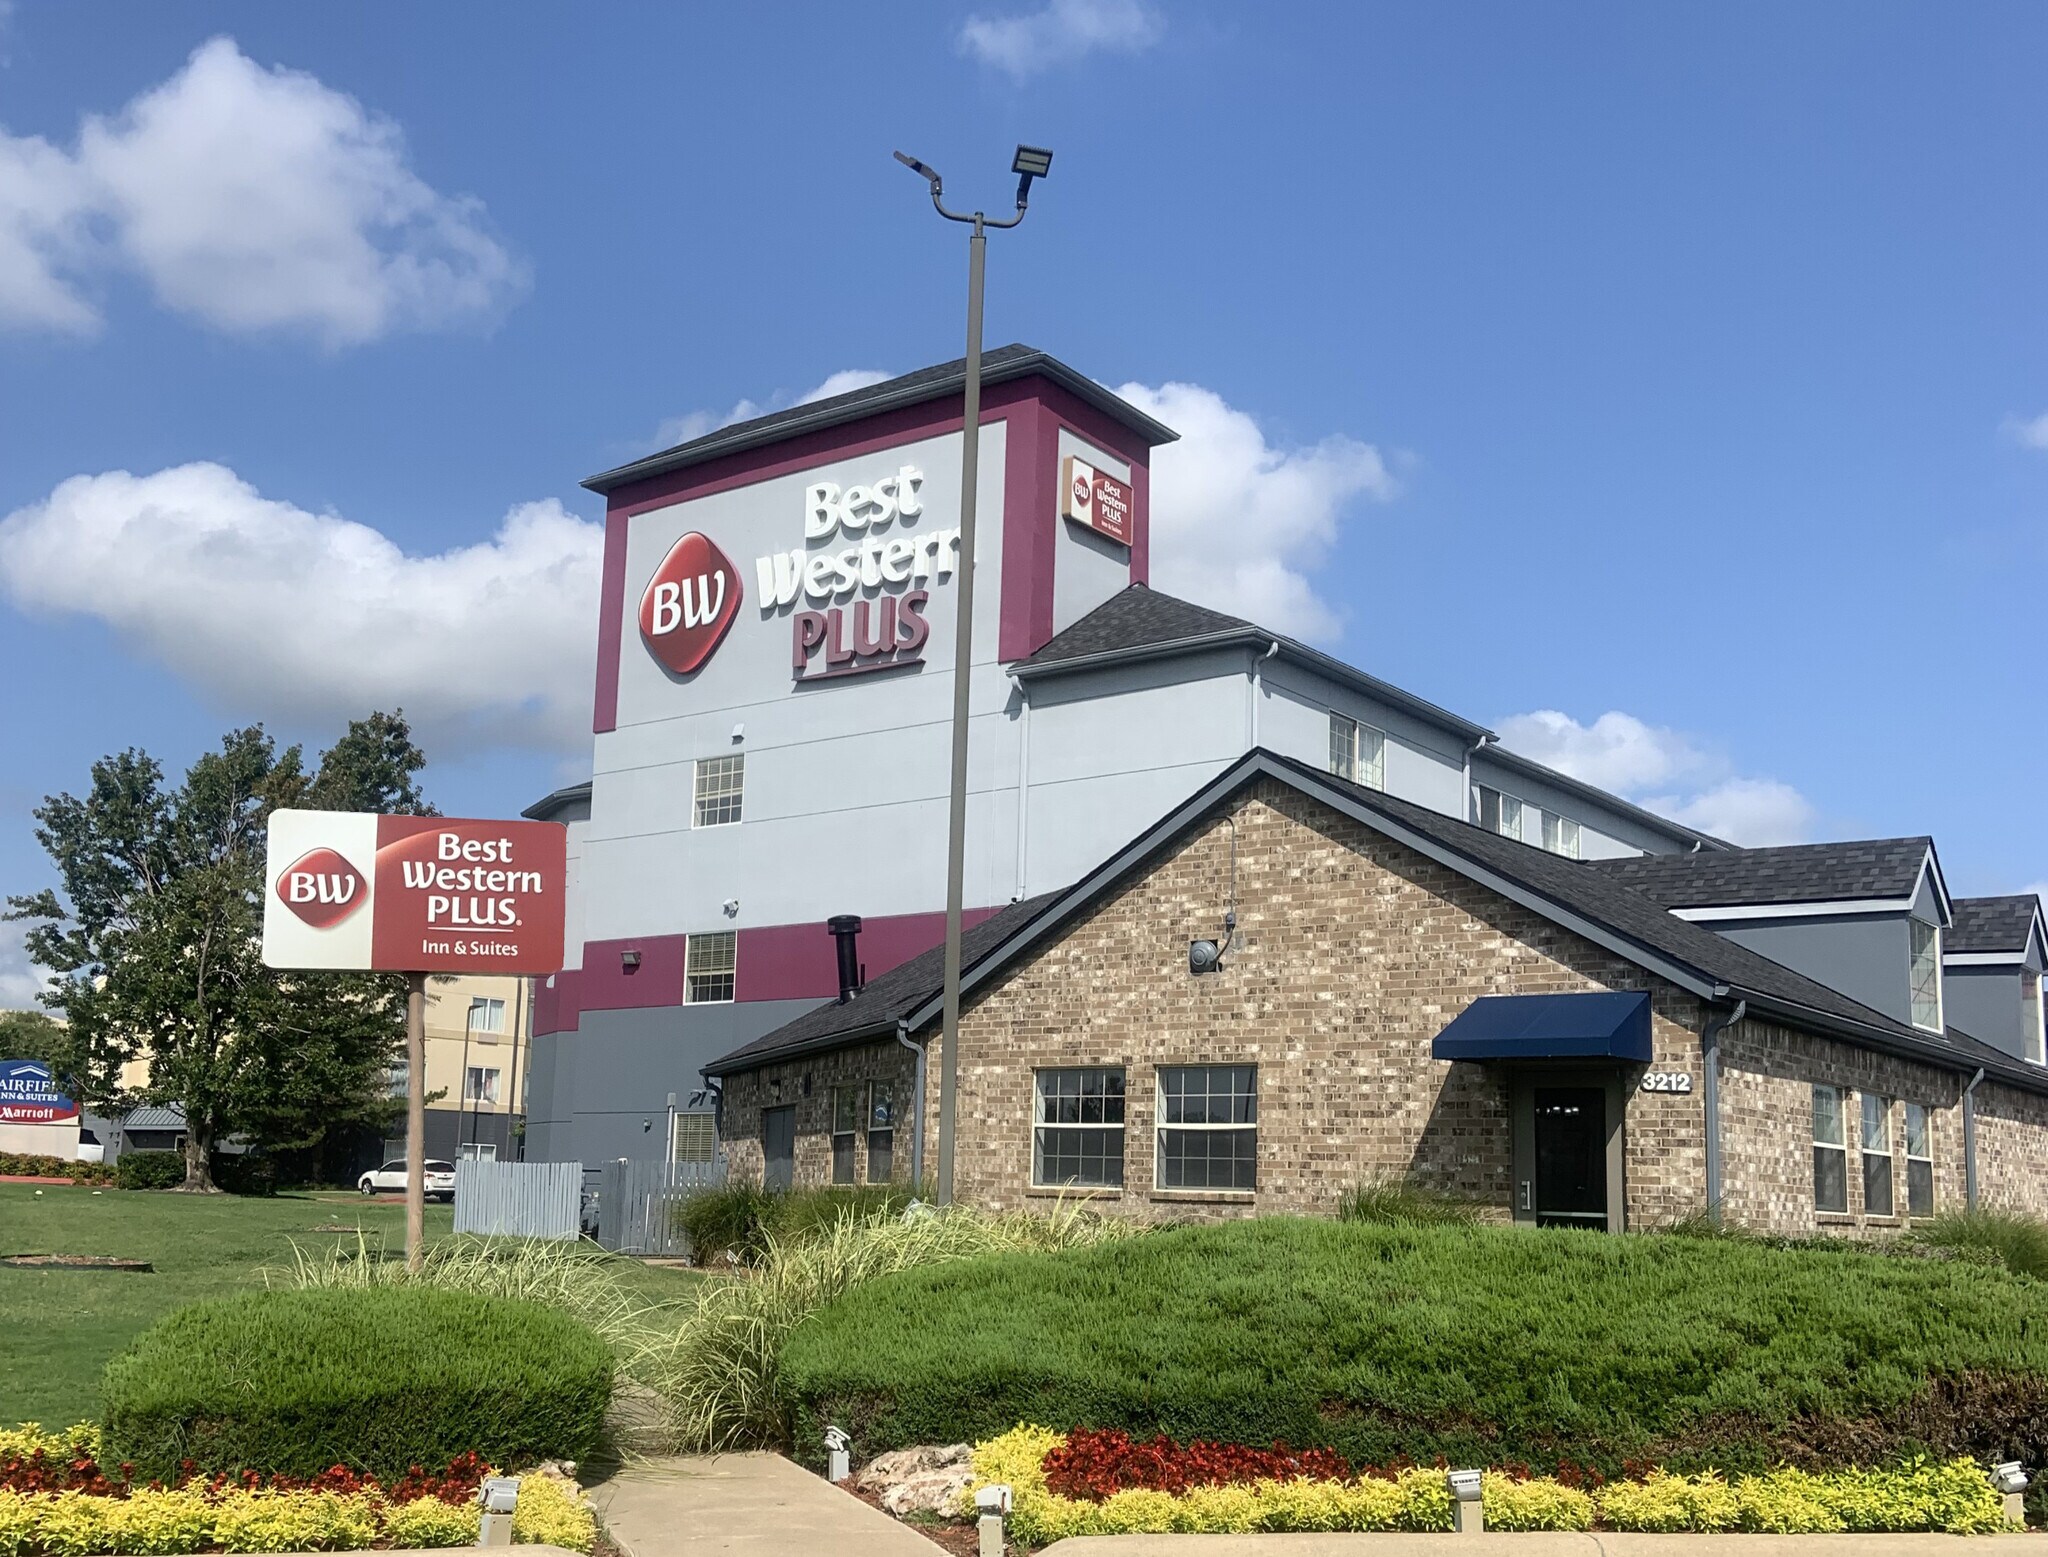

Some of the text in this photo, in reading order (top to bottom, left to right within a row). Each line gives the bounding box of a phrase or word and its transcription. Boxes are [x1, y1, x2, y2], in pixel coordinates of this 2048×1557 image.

[1074, 482, 1089, 499] BW
[1104, 480, 1121, 498] Best
[805, 465, 923, 539] Best
[1097, 488, 1127, 513] Western
[1102, 503, 1121, 522] PLUS
[652, 569, 726, 635] BW
[792, 590, 930, 669] PLUS
[437, 833, 513, 863] Best
[289, 872, 356, 905] BW
[402, 861, 542, 894] Western
[422, 939, 518, 956] Inn & Suites
[1642, 1072, 1691, 1091] 3212
[17, 1092, 24, 1100] &
[26, 1093, 58, 1102] SUITES
[0, 1106, 53, 1119] Marriott
